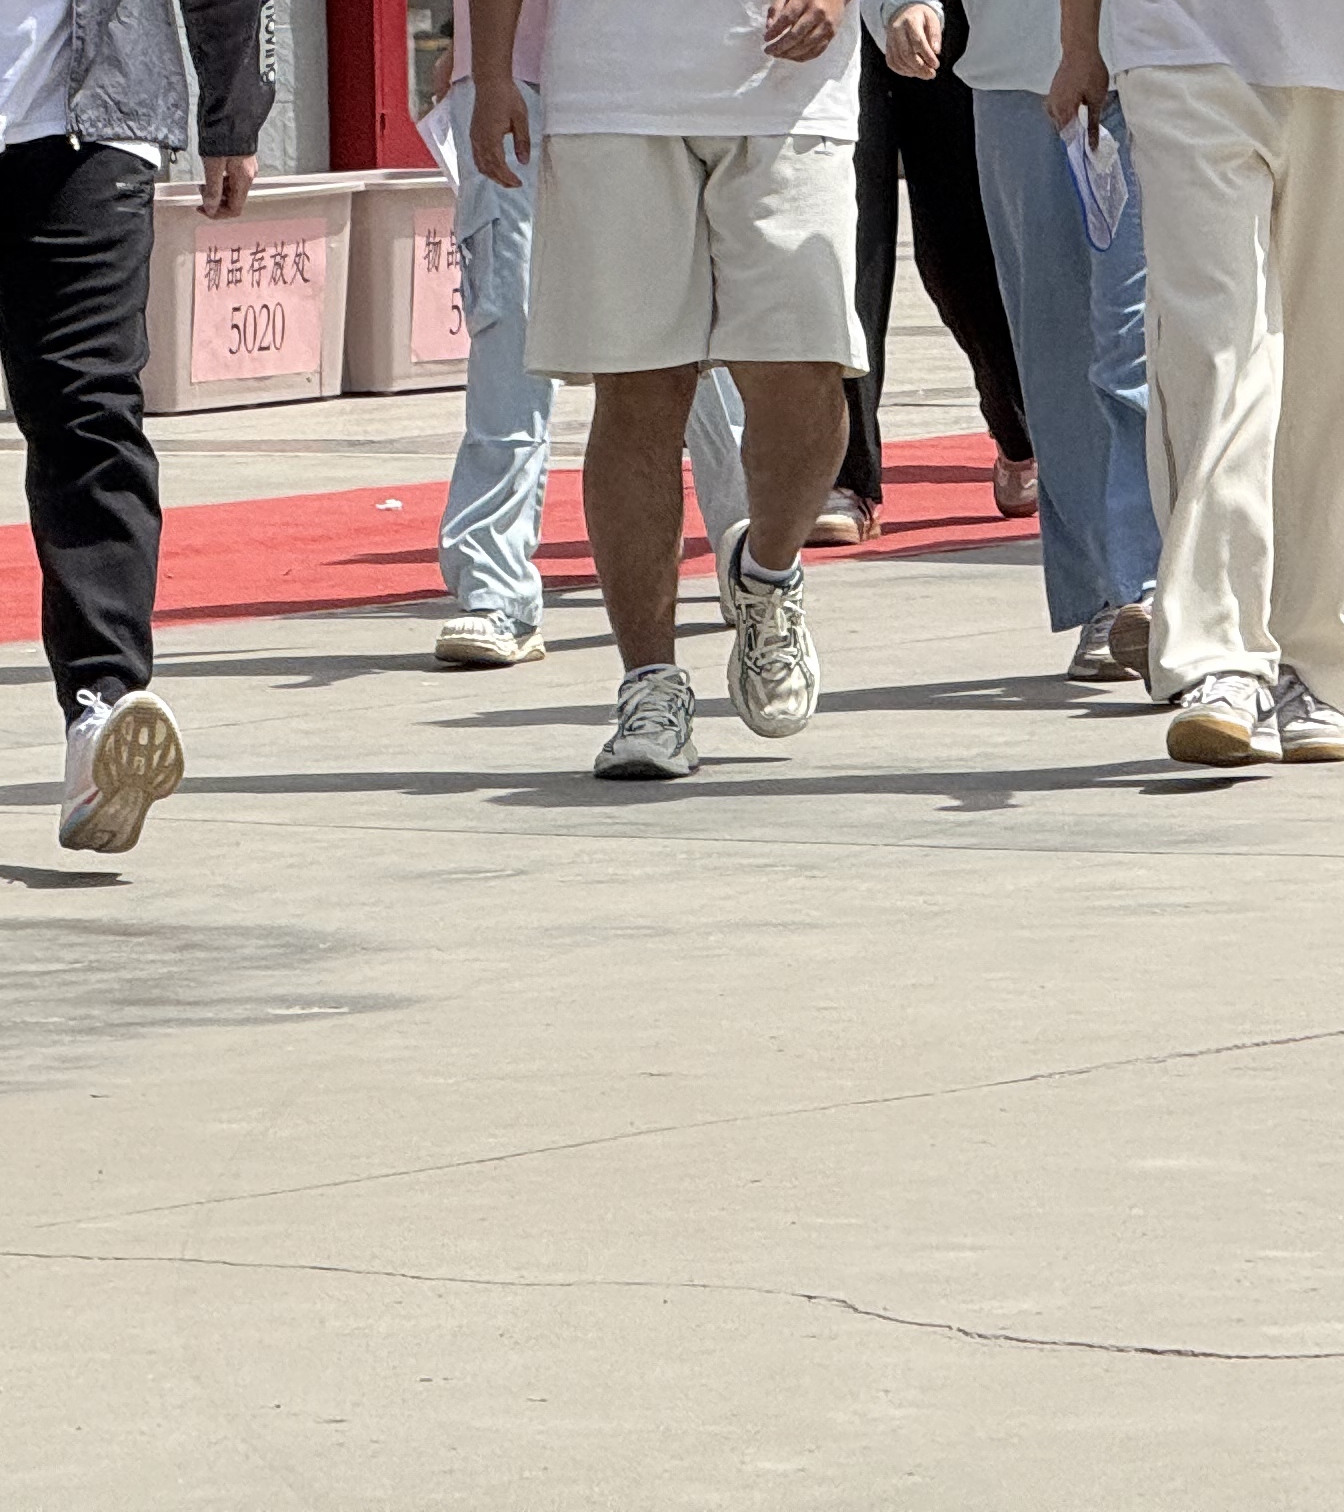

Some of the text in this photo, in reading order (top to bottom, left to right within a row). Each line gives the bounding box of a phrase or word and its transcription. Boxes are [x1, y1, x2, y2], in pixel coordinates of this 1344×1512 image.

[204, 239, 311, 292] 物品存放处
[228, 301, 286, 355] 5020
